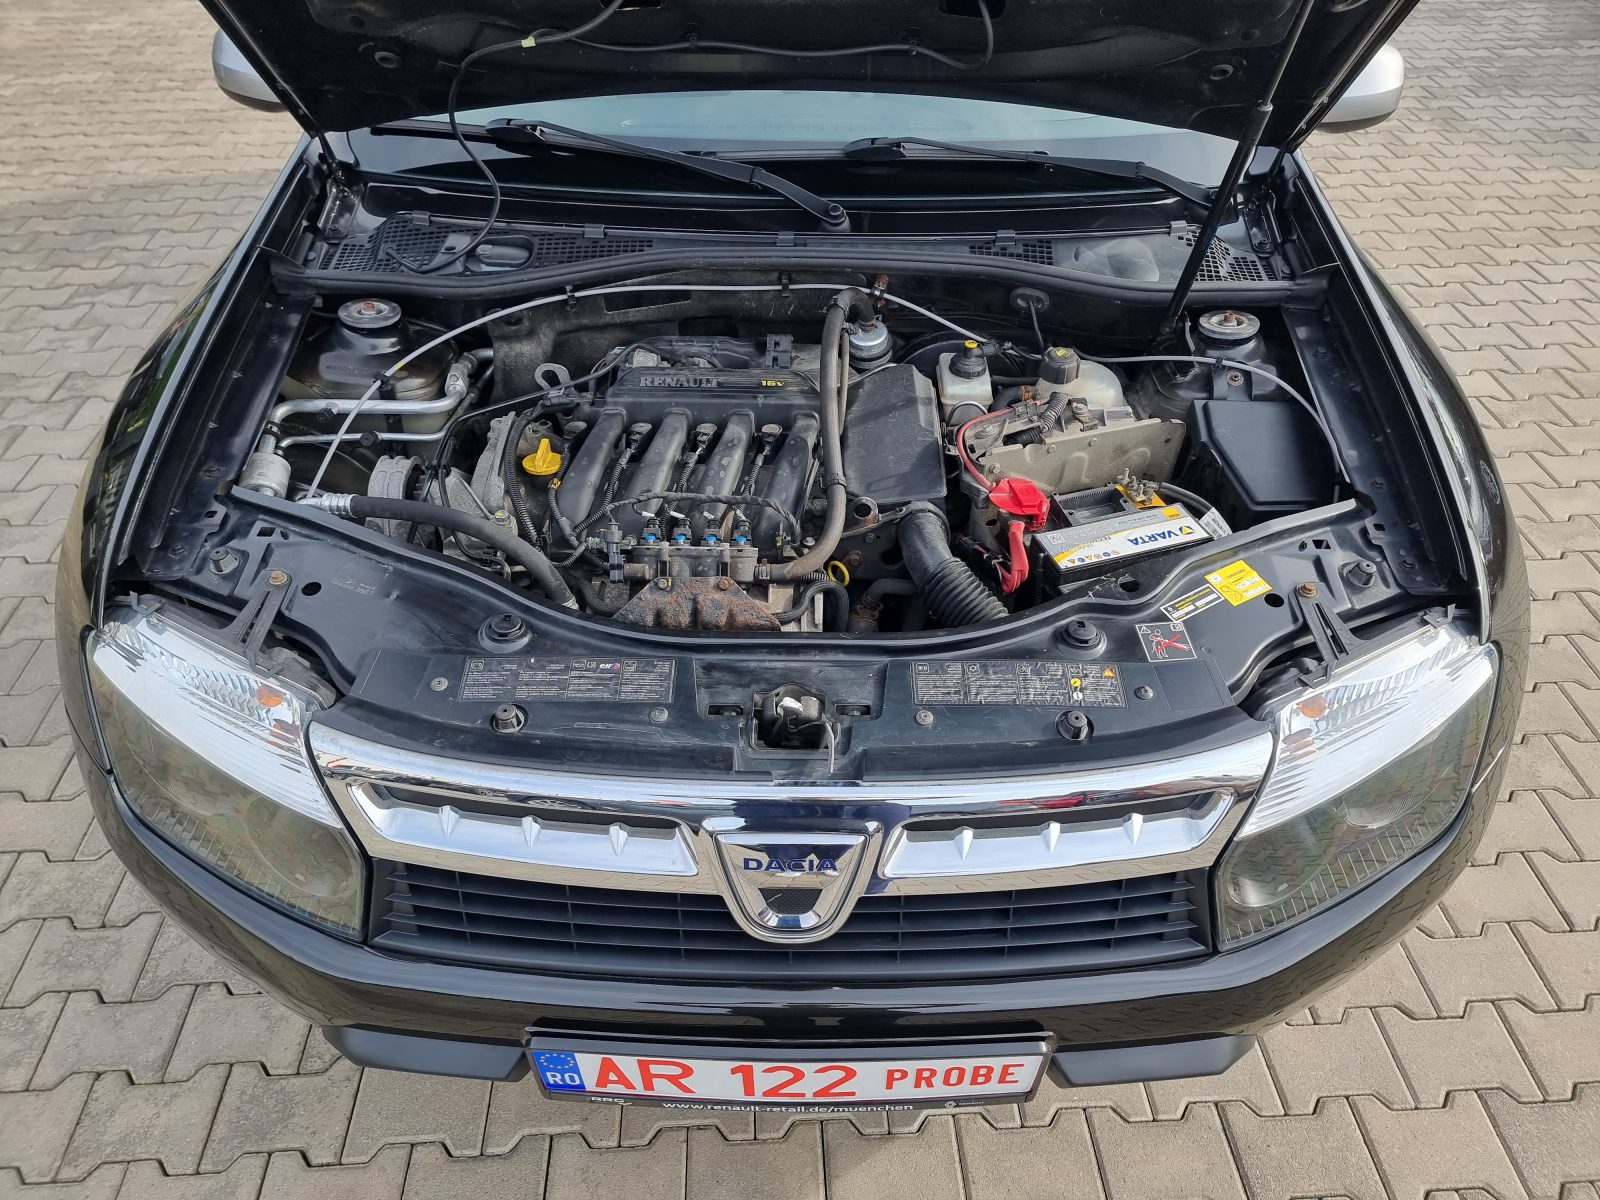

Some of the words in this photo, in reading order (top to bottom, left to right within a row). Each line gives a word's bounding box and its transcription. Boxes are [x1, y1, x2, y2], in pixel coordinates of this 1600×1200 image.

[639, 376, 723, 388] RENAULT
[1127, 530, 1179, 545] VARTA
[743, 857, 839, 873] DACIA
[545, 1071, 581, 1087] RO
[595, 1056, 697, 1095] AR
[730, 1064, 858, 1098] 122
[885, 1063, 1025, 1090] PROBE
